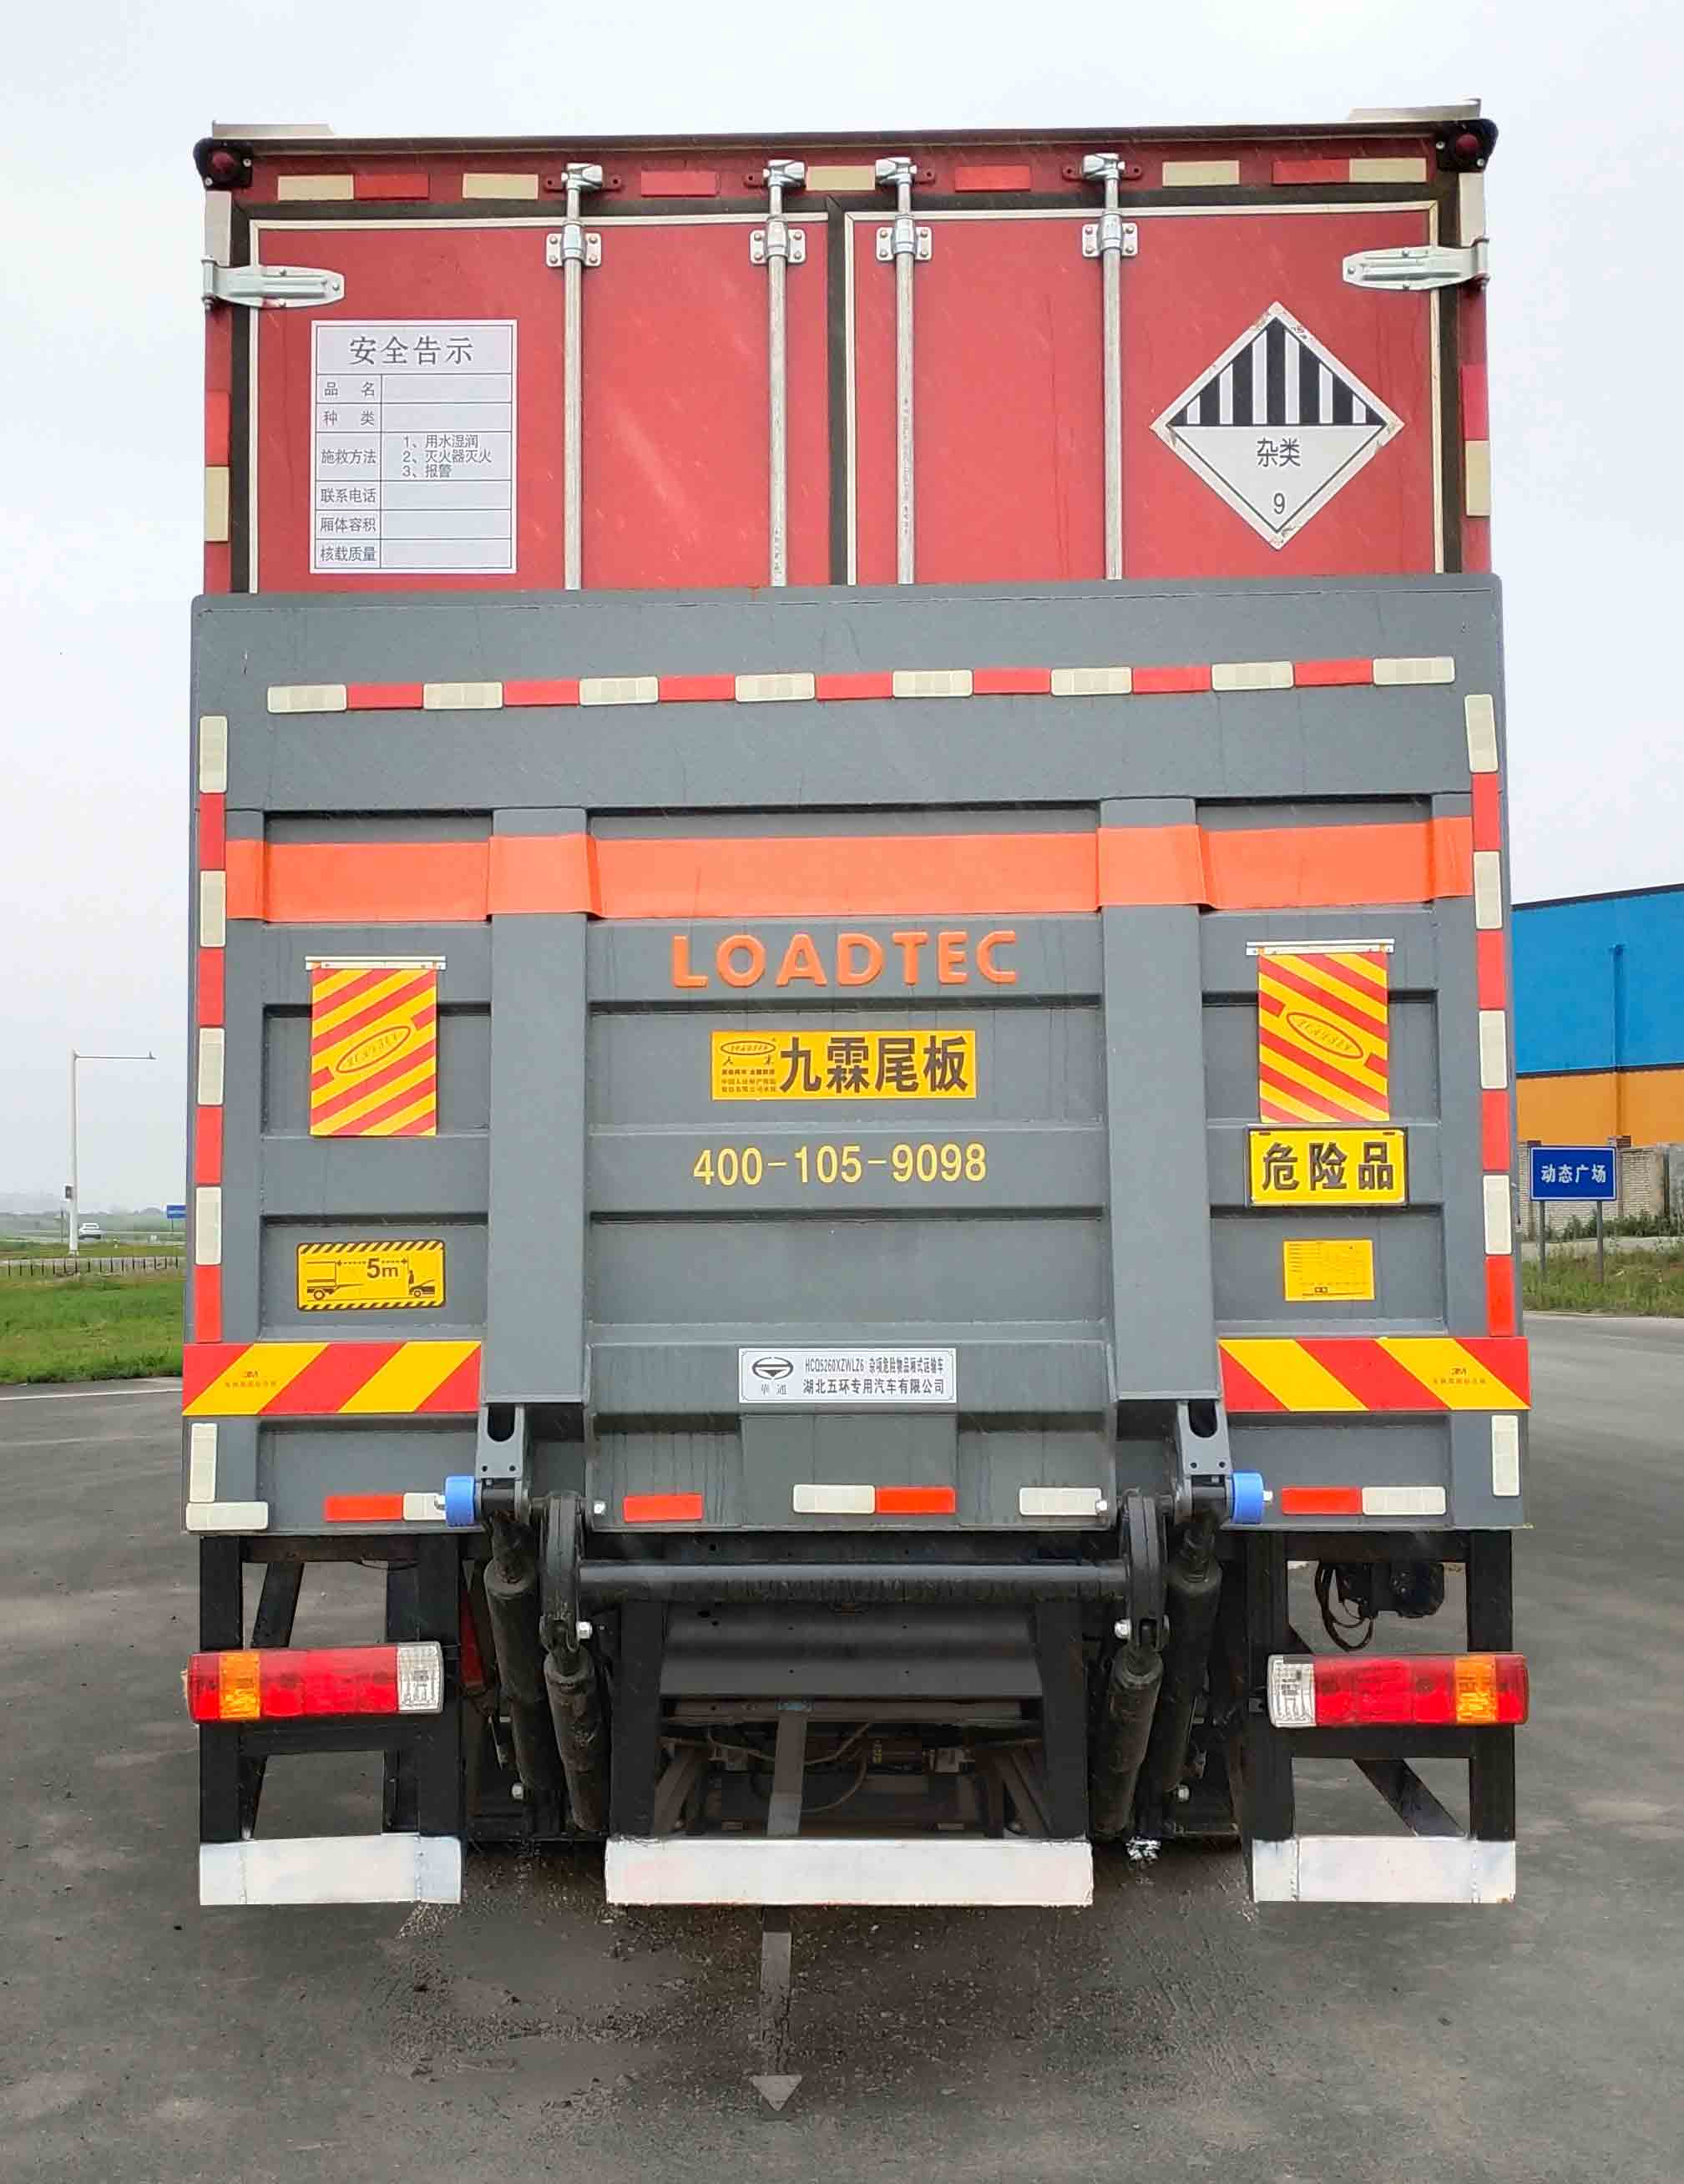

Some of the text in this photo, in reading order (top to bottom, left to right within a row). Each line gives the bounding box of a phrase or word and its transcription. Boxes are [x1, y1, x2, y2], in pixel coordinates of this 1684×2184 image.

[349, 336, 473, 366] 安全告示
[321, 447, 377, 465] 施救方法
[1256, 437, 1302, 468] 杂类
[321, 487, 377, 503] 联系电话
[1273, 493, 1287, 515] 9
[321, 517, 377, 533] 厢体容积
[321, 545, 376, 562] 核载质量
[671, 929, 1017, 988] LOADTEC
[779, 1034, 968, 1093] 九霖尾板
[692, 1142, 988, 1187] 400-105-9098
[1262, 1141, 1394, 1191] 危险品
[1541, 1163, 1606, 1184] 动态广场
[367, 1257, 399, 1279] 5m
[802, 1378, 945, 1395] 湖北五环专用汽车有限公司
